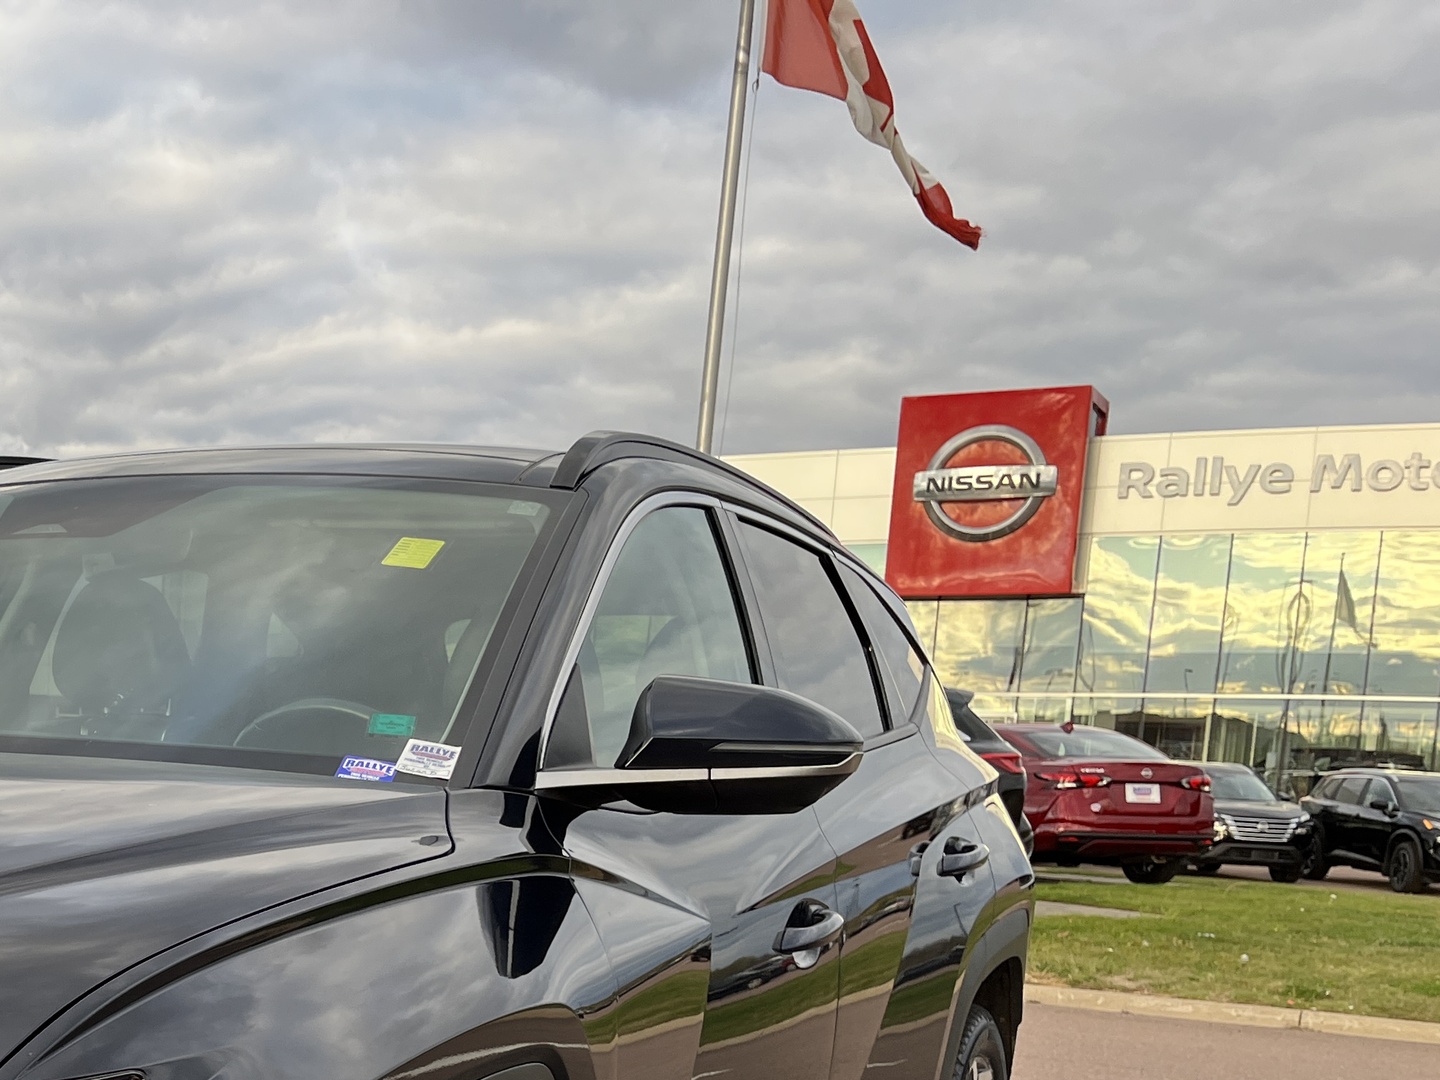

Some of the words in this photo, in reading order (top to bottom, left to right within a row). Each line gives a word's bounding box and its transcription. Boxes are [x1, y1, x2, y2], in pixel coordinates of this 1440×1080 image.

[925, 472, 1042, 494] NISSAN
[1117, 456, 1295, 507] Rallye
[1309, 452, 1440, 493] Mot
[410, 744, 457, 760] RALLYE
[345, 759, 394, 775] RALLYE
